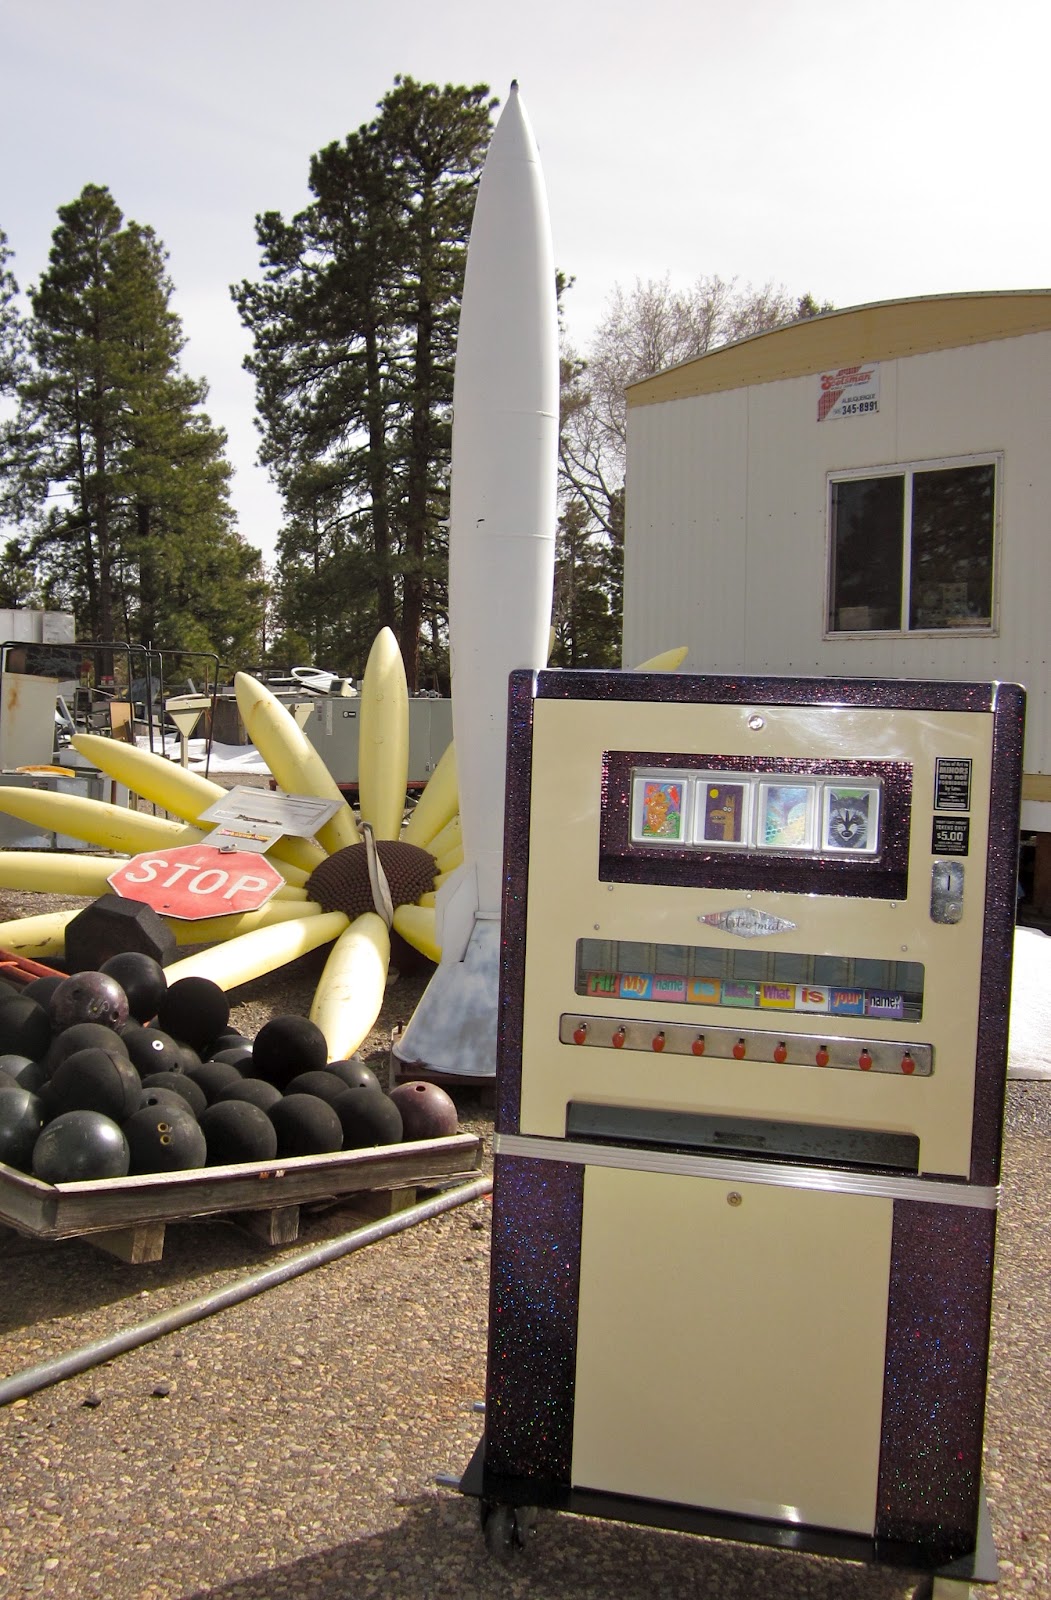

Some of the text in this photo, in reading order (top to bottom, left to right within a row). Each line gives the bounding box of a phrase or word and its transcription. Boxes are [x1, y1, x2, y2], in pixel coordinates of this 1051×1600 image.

[842, 393, 876, 403] ALBUQUERQUE
[842, 401, 878, 415] 345-8991
[936, 832, 963, 841] $5.00
[125, 859, 268, 899] STOP
[623, 975, 649, 996] My
[656, 979, 685, 992] name
[763, 985, 791, 1000] What
[801, 987, 825, 1003] is
[833, 991, 862, 1007] your
[871, 995, 902, 1010] name?
